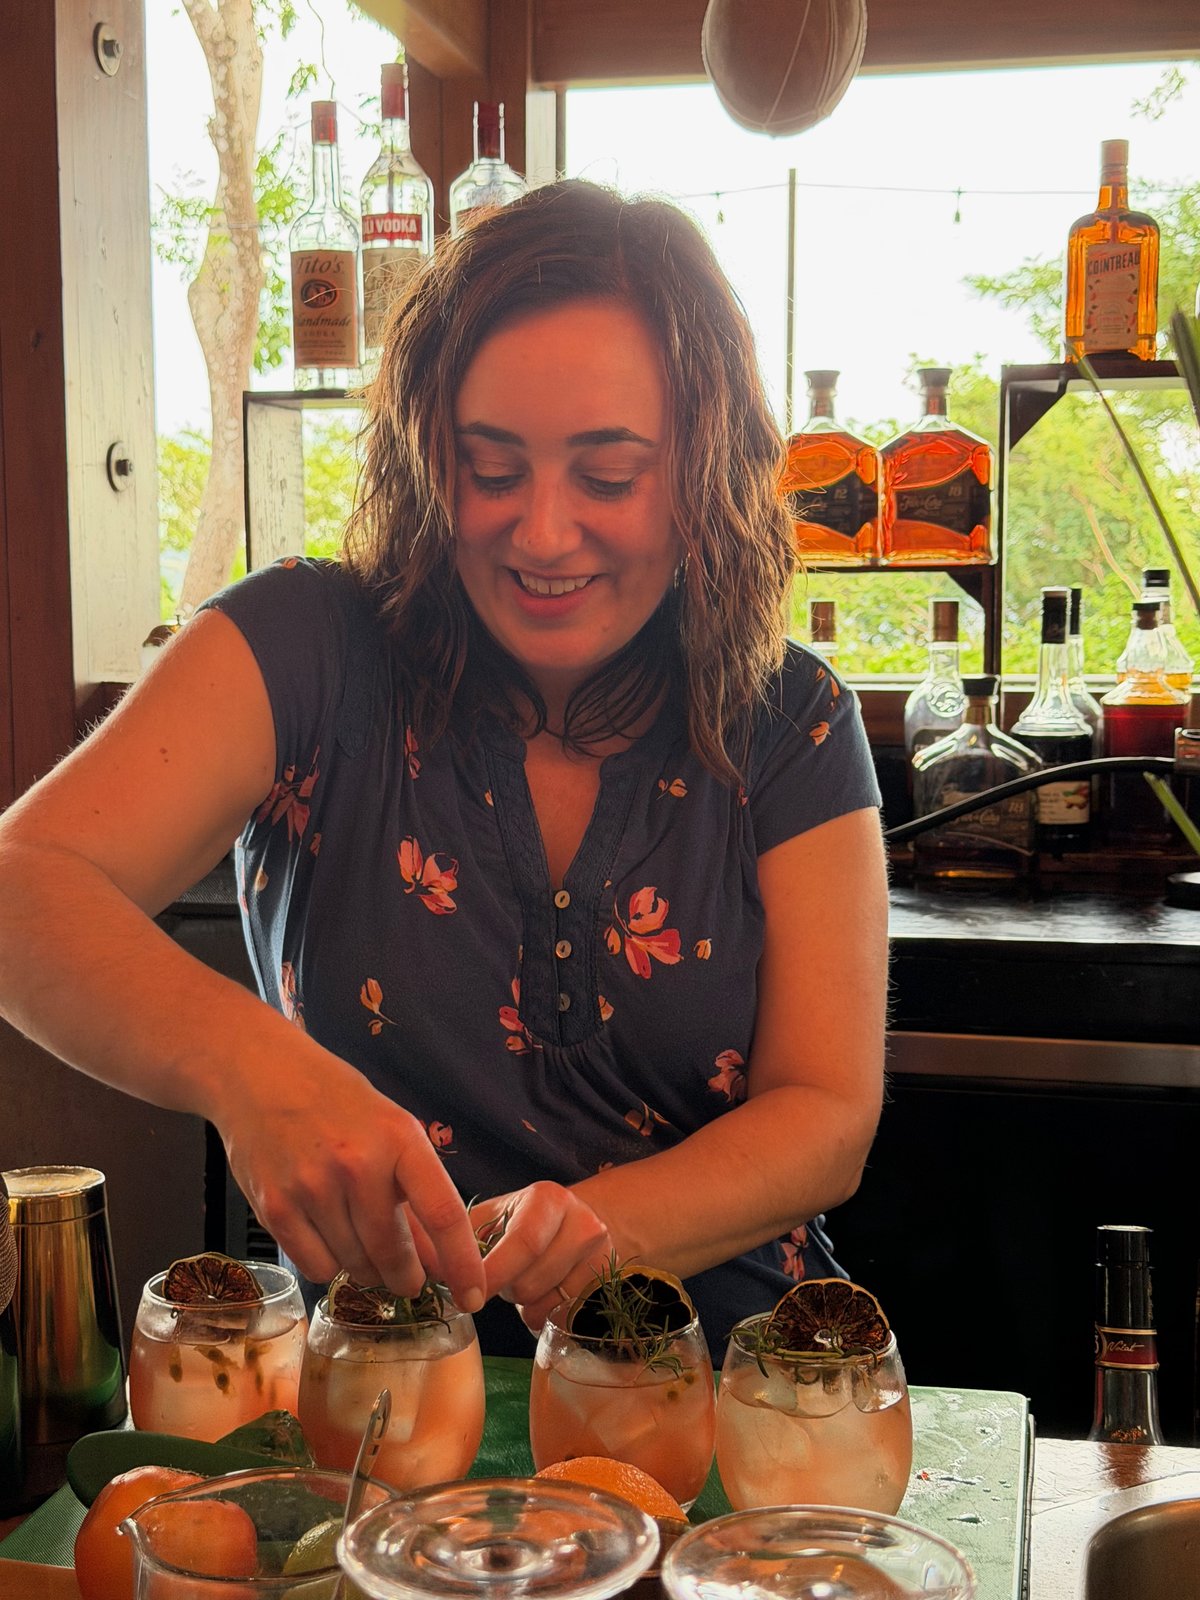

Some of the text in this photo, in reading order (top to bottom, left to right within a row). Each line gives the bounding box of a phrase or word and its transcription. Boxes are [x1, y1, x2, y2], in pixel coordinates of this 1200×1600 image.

[375, 218, 417, 233] VODKA
[296, 254, 345, 274] Tito's
[1087, 250, 1140, 276] COINTREAU
